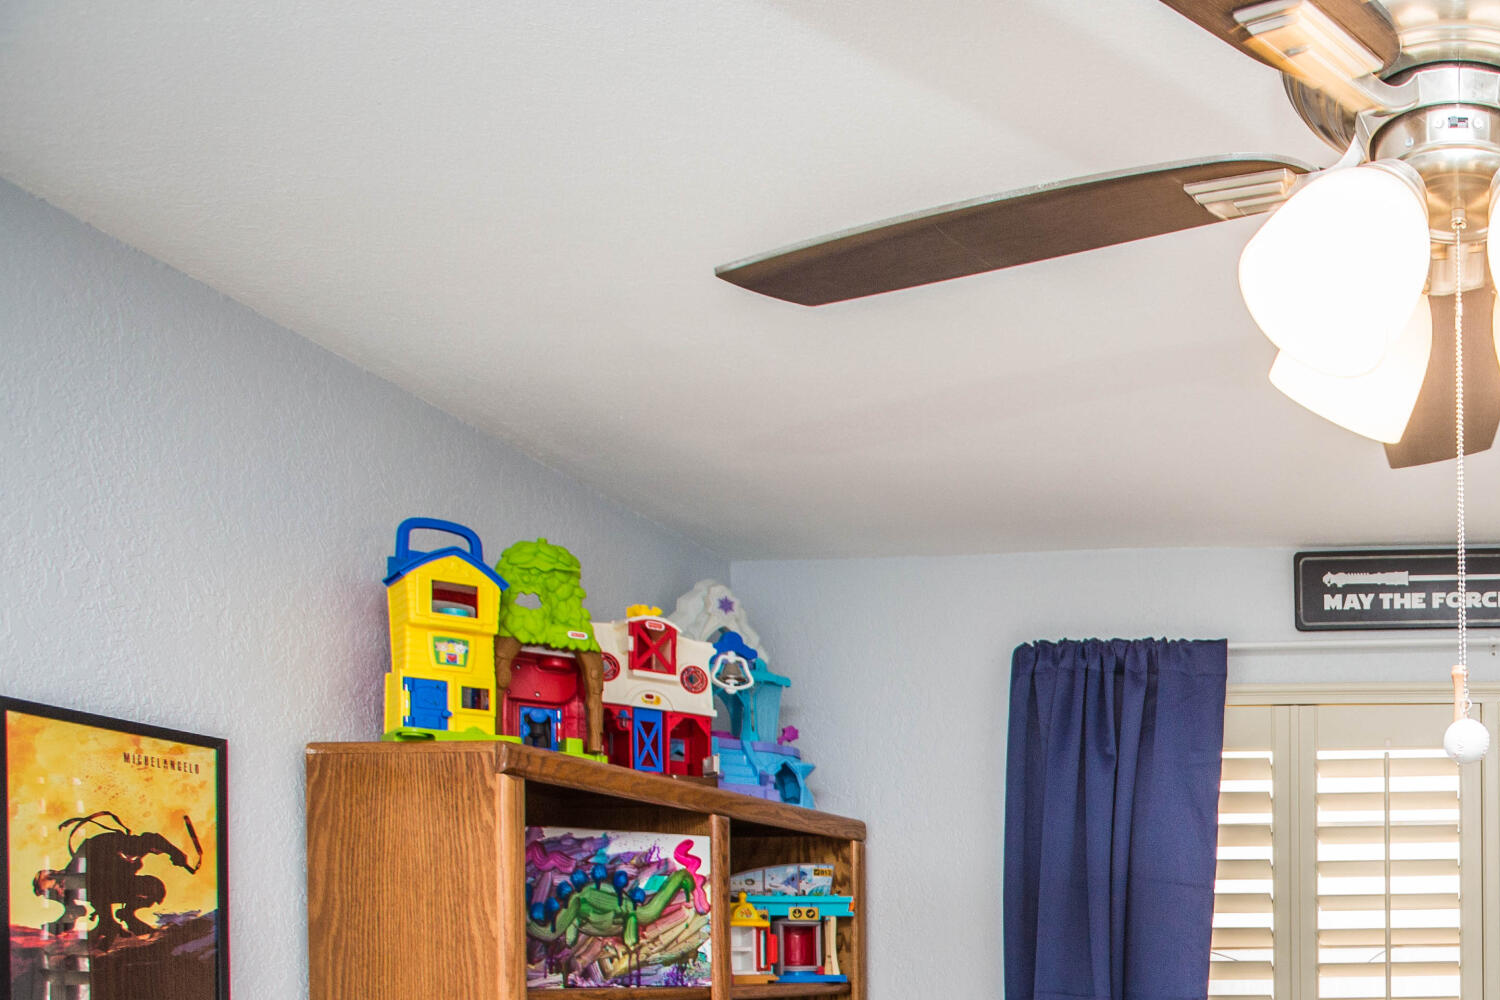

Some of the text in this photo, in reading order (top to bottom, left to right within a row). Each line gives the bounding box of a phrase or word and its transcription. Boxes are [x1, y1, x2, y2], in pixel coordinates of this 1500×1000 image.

[1323, 593, 1375, 610] MAY
[1378, 592, 1426, 609] THE
[123, 751, 199, 774] MICHELANGELO
